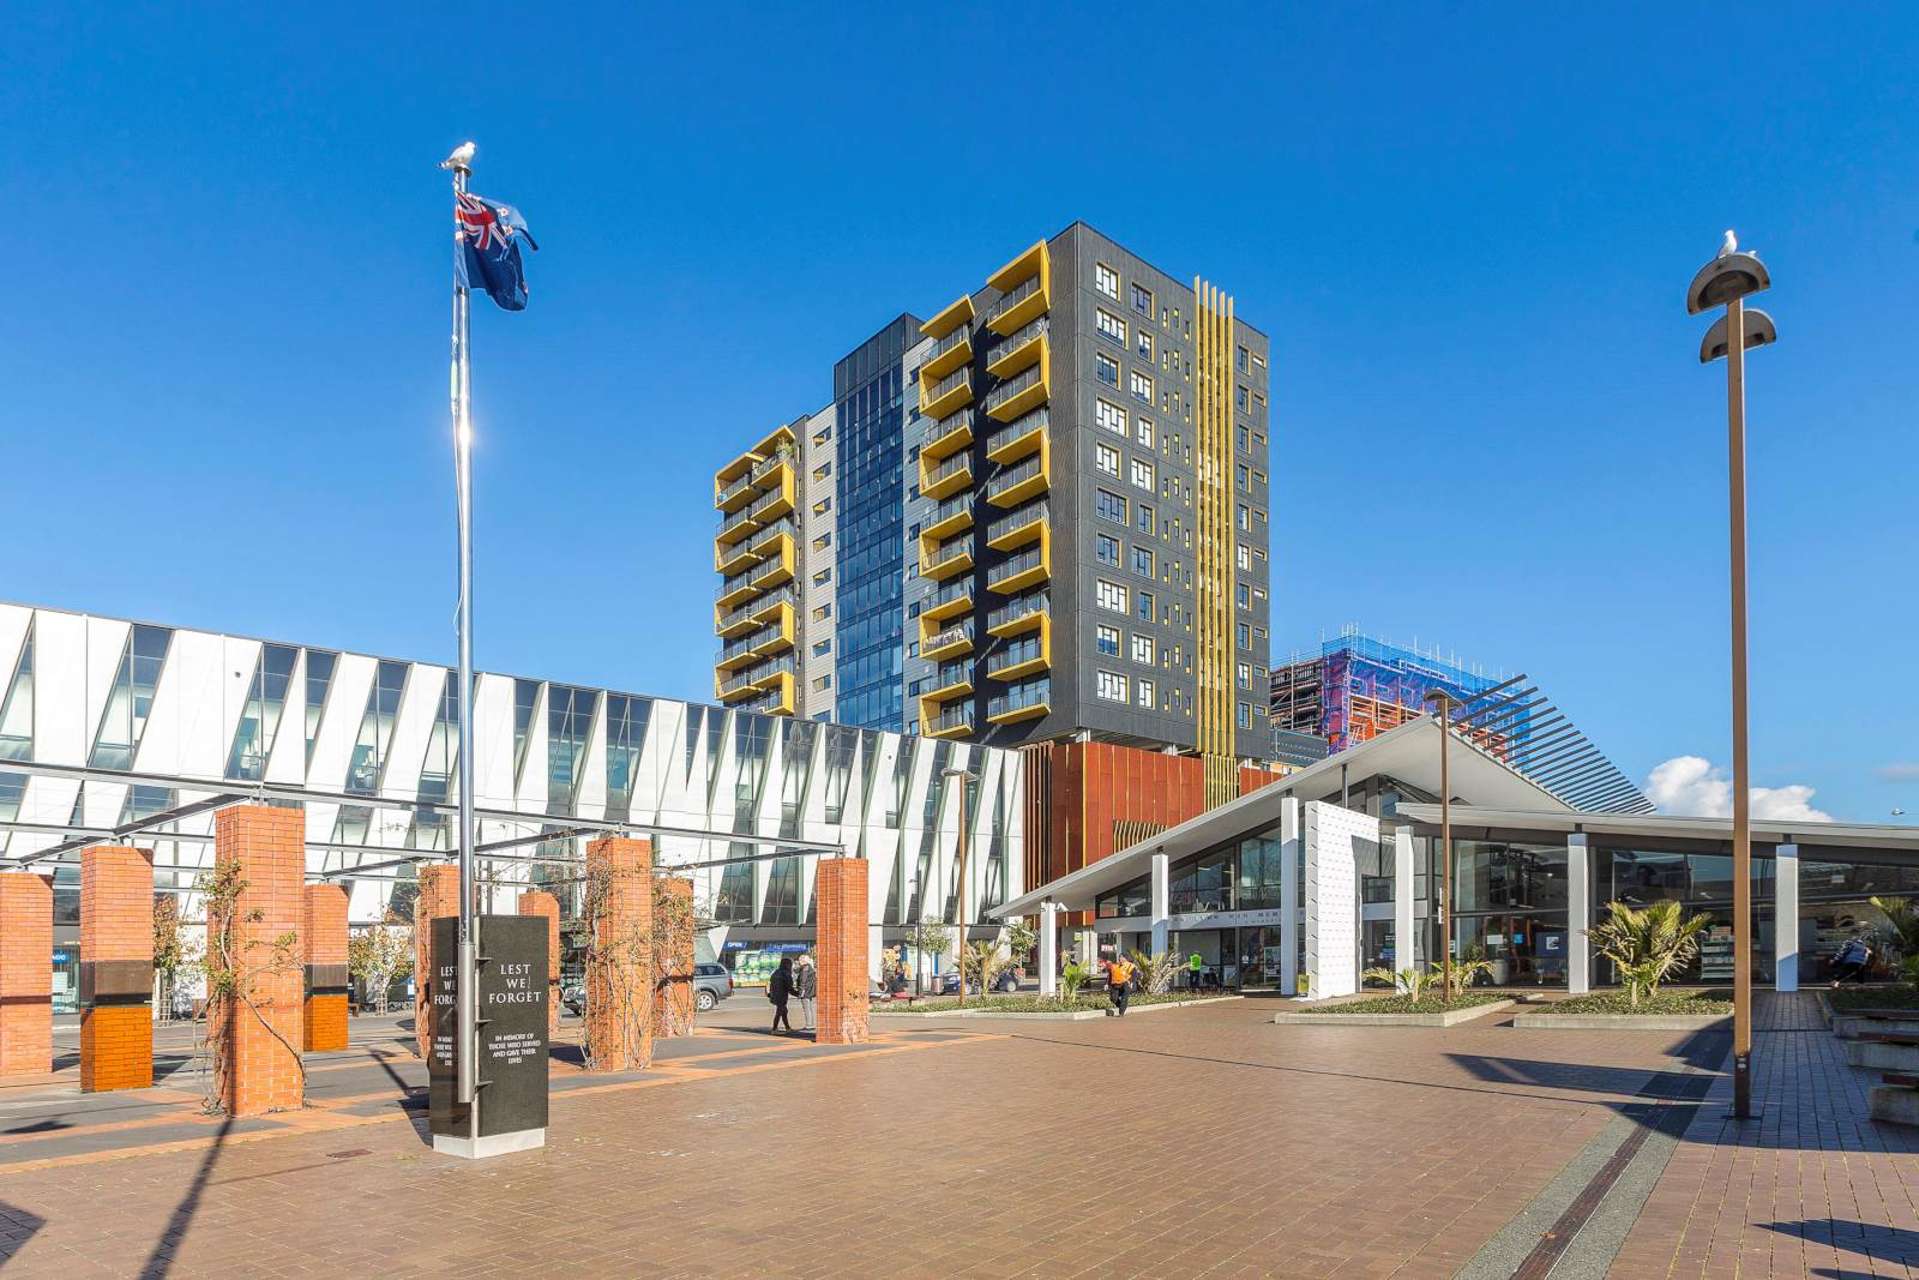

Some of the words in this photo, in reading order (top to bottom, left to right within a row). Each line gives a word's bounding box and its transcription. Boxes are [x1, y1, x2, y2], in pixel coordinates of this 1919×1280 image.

[501, 963, 531, 974] LEST
[506, 978, 526, 989] WE
[434, 994, 457, 1005] FORG
[488, 992, 541, 1004] FORGET
